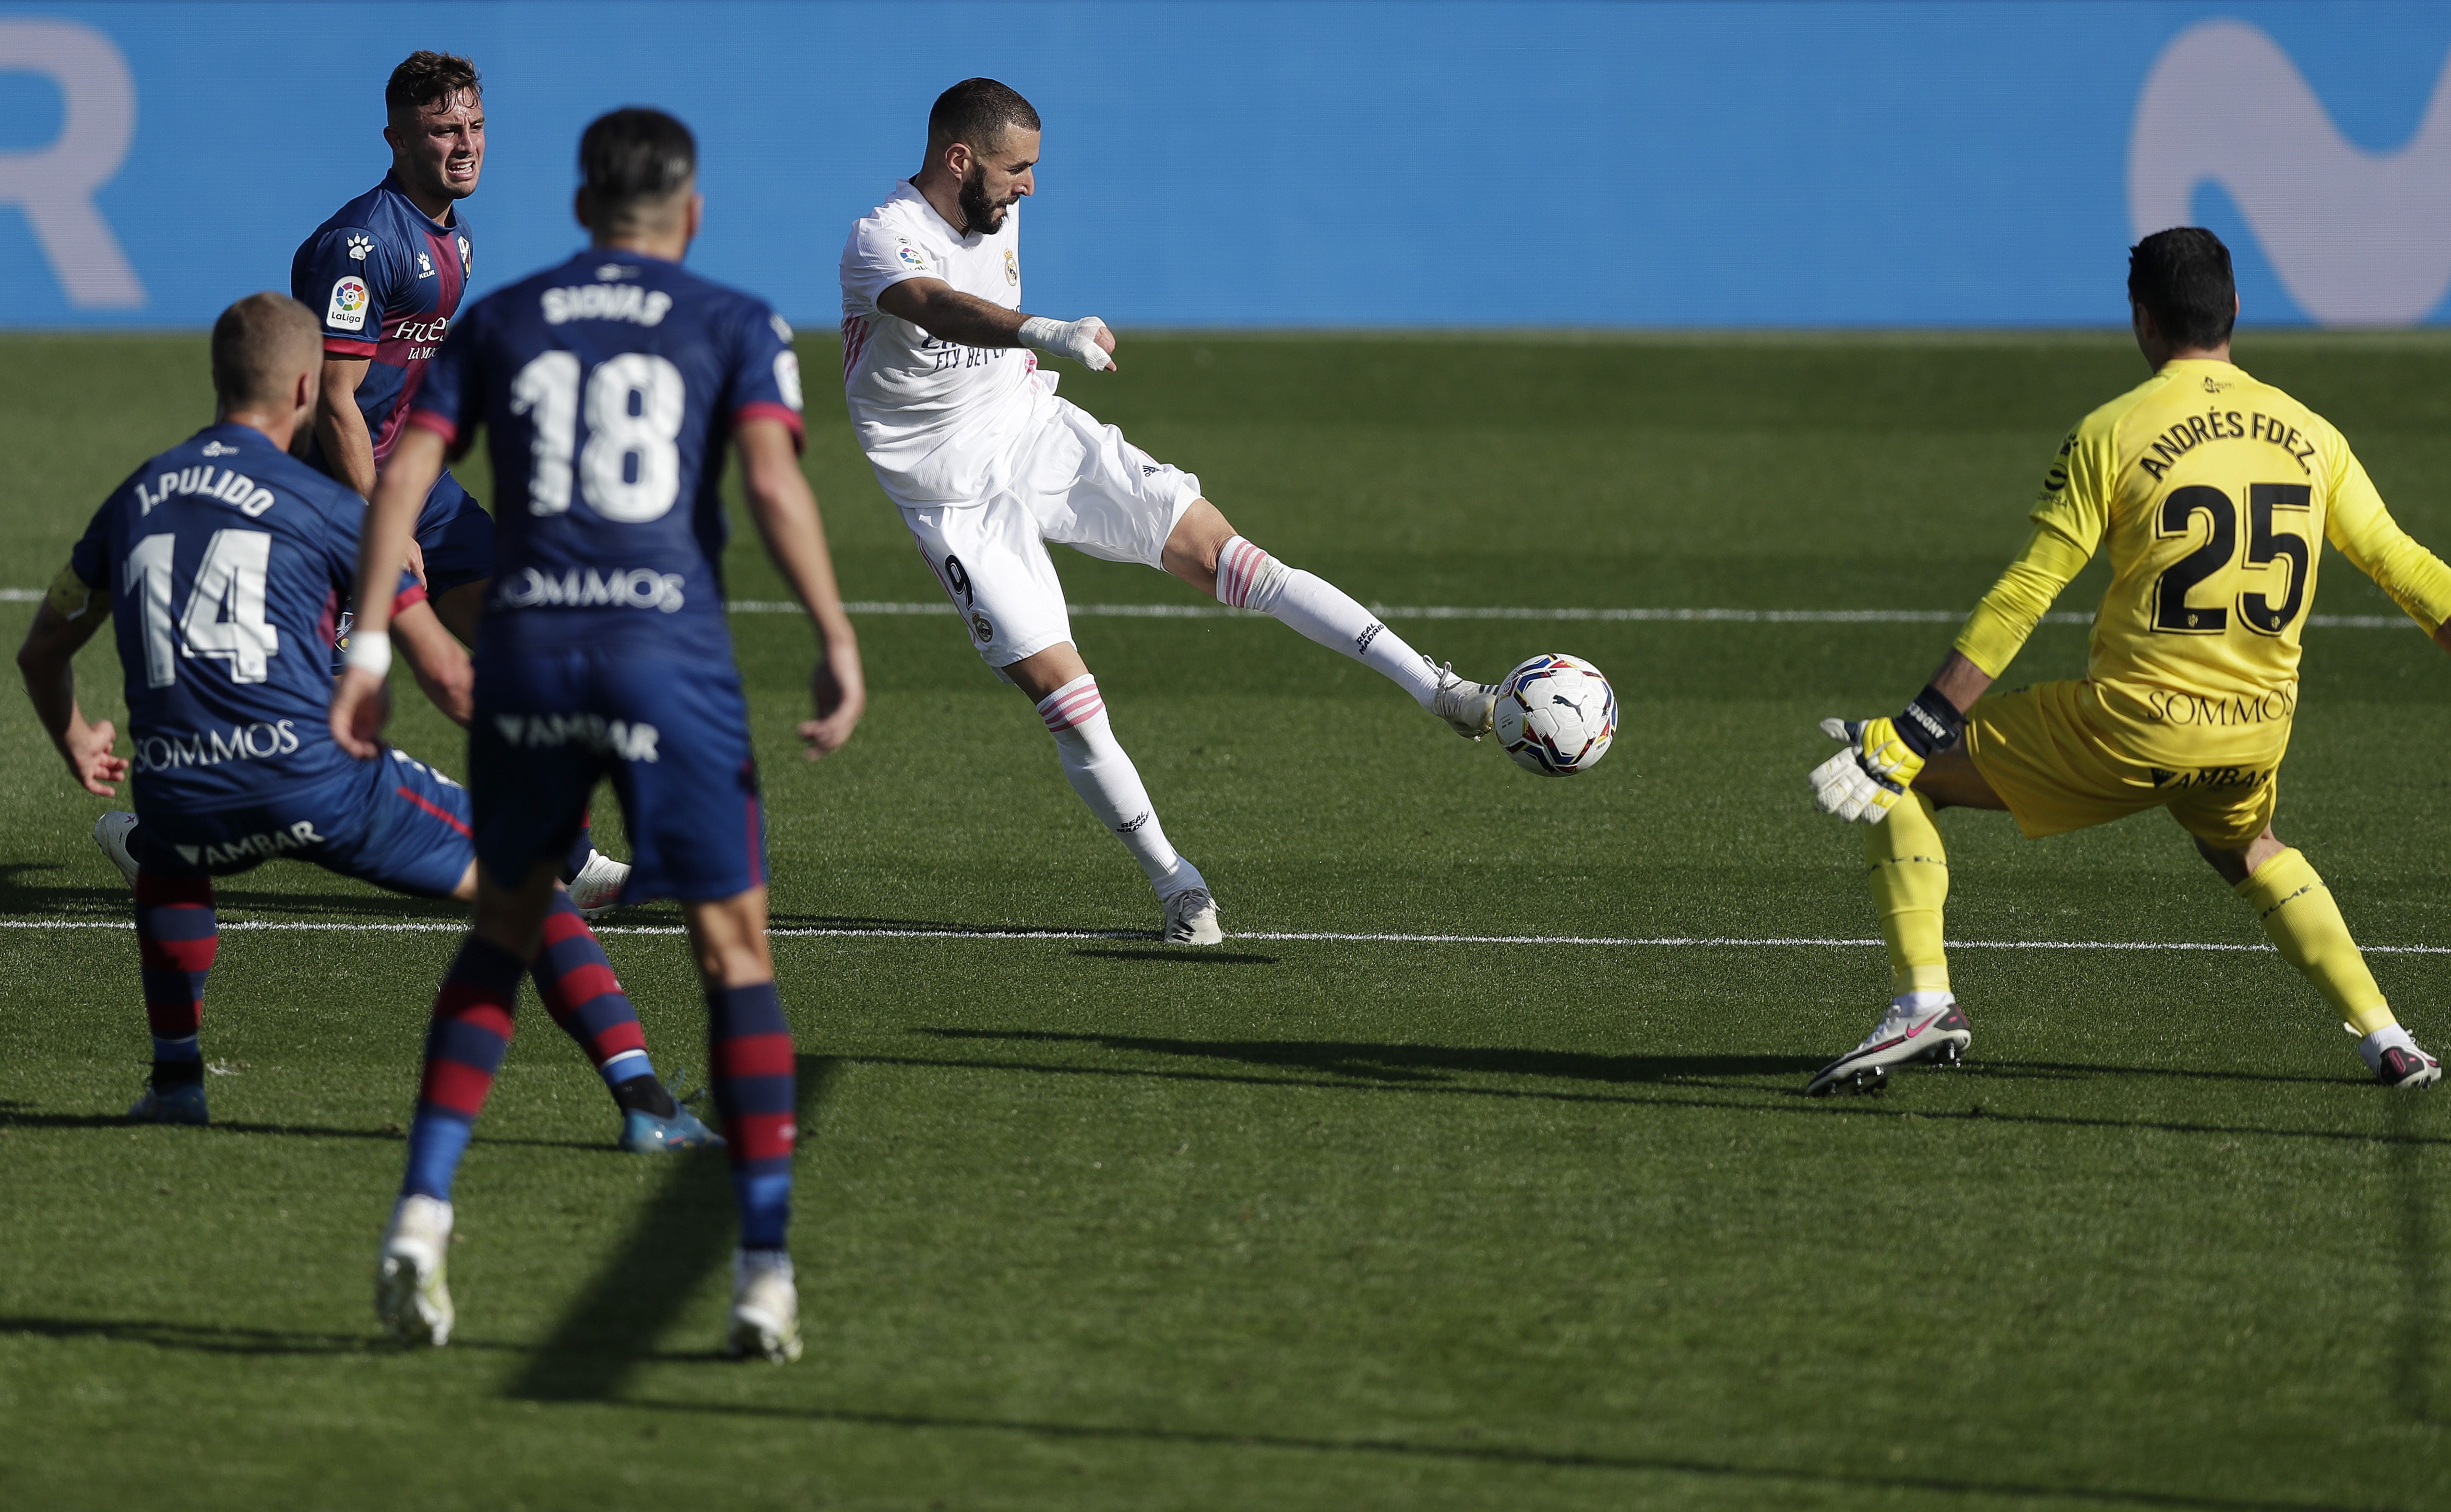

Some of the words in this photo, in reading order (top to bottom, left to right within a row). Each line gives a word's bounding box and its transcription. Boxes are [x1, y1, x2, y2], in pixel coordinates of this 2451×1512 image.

[331, 312, 361, 324] LaLiga
[510, 350, 685, 523] 18
[2140, 406, 2244, 483] ANDRÉS
[2250, 411, 2316, 475] FDEZ.
[134, 464, 276, 518] J.PULIDO
[944, 554, 974, 611] 9
[2149, 481, 2312, 637] 25
[122, 528, 279, 689] 14
[1356, 623, 1376, 645] REAL
[1359, 624, 1384, 655] MADRID
[2148, 682, 2293, 725] SOMMOS
[135, 718, 300, 773] SOMMOS
[205, 820, 325, 866] AMBAR
[1121, 812, 1146, 828] REAL
